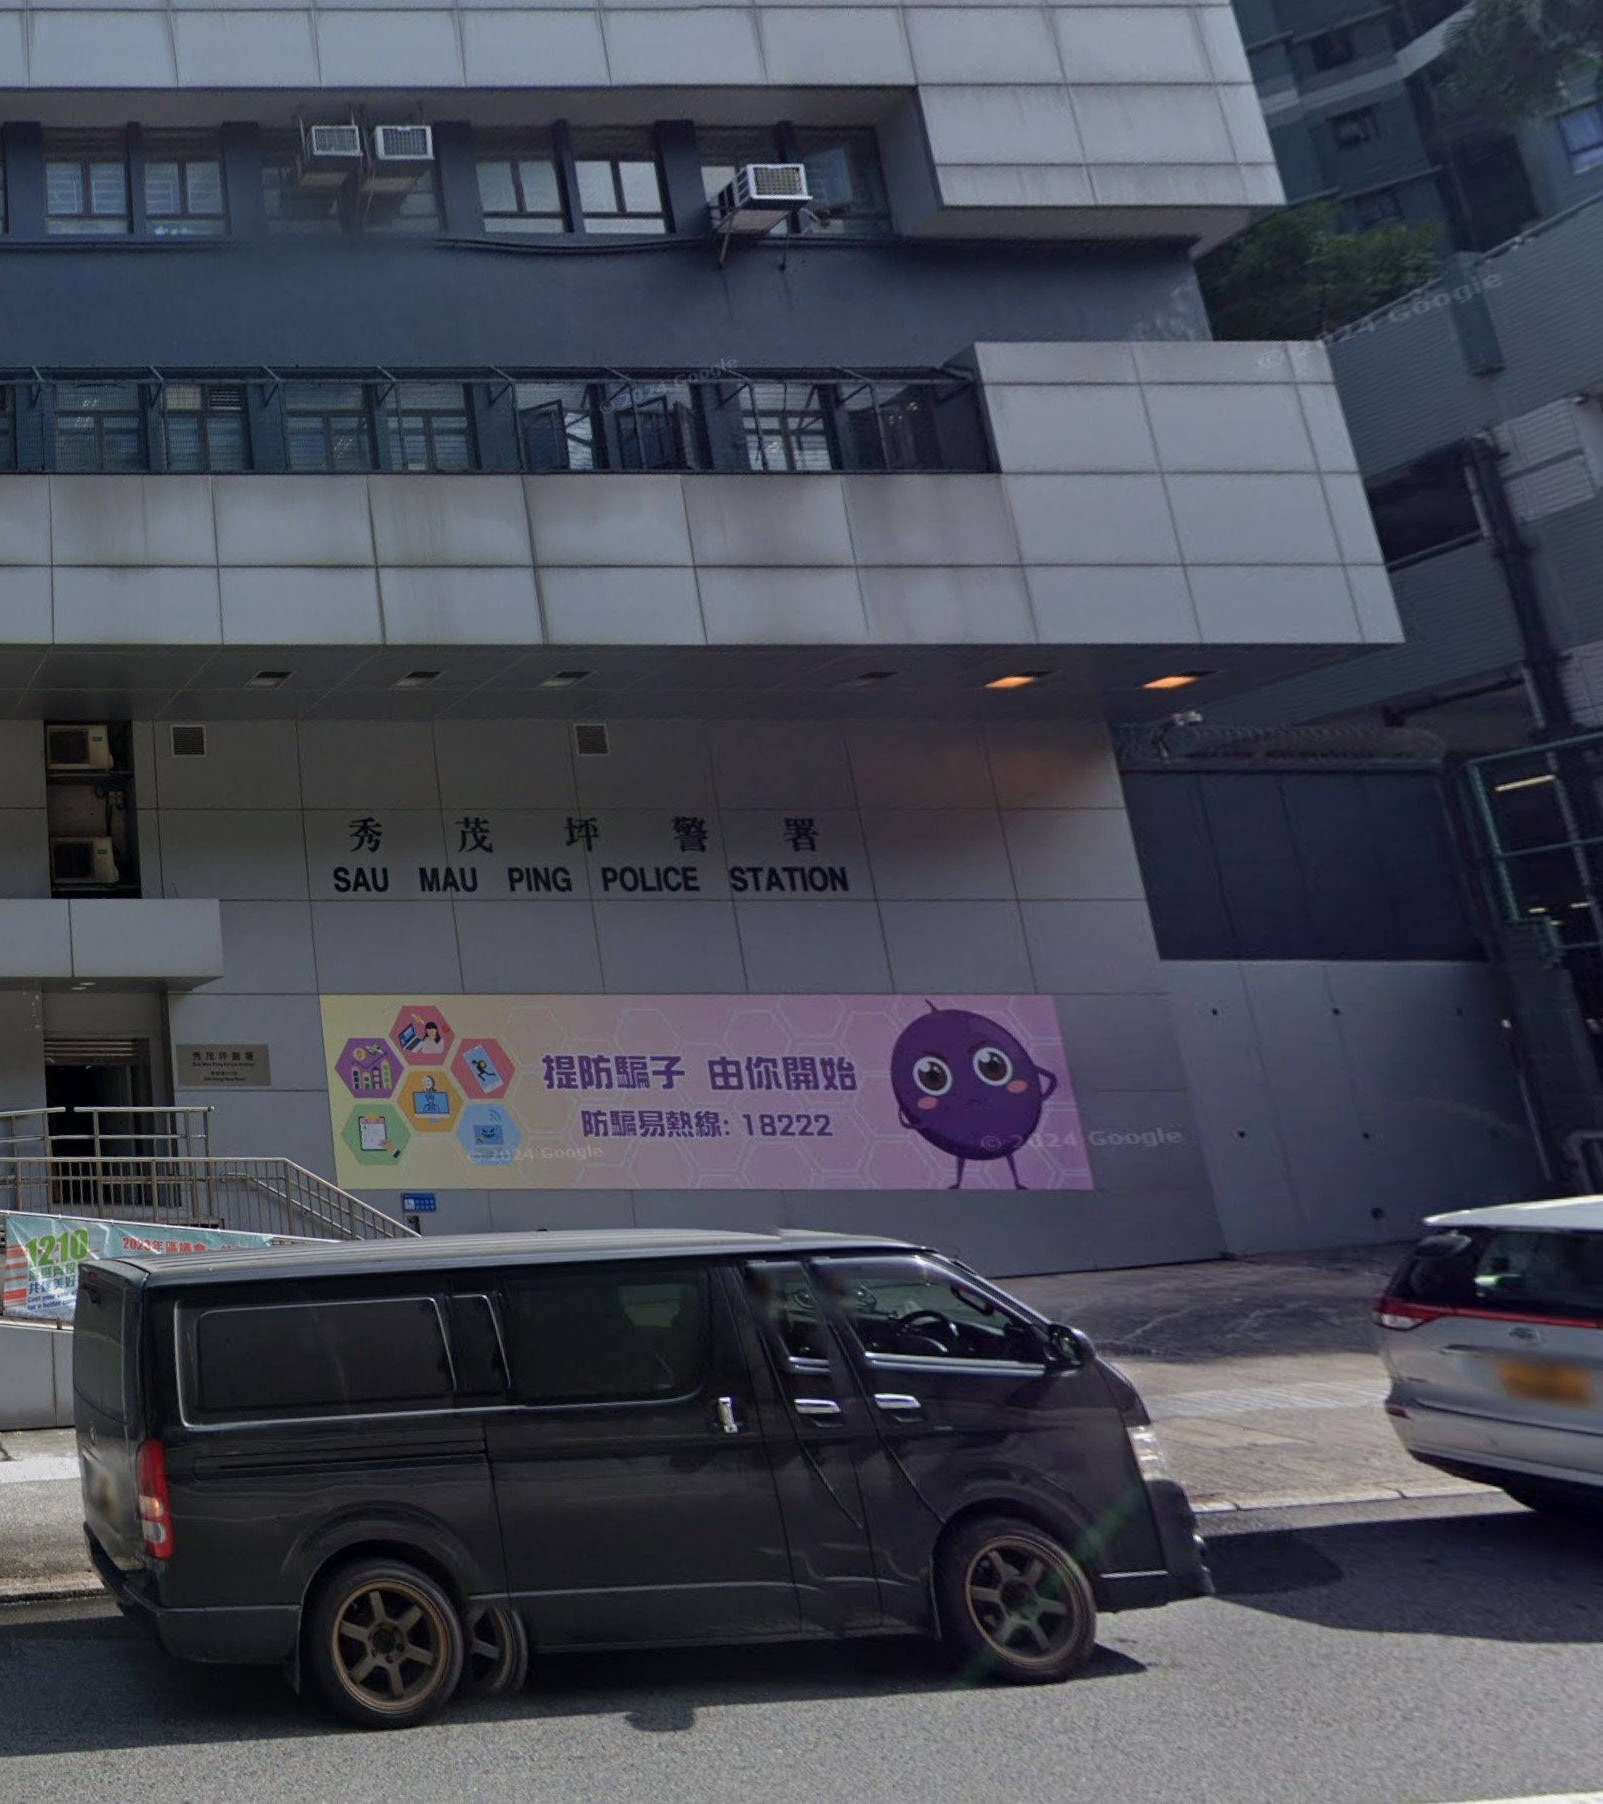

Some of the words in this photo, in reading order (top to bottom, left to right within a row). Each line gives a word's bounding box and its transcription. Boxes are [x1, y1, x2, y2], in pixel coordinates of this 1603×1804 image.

[349, 815, 818, 854] 秀茂坪警署
[332, 866, 390, 893] SAU
[418, 866, 478, 893] MAU
[508, 866, 572, 893] PING
[601, 866, 701, 893] POLICE
[729, 866, 850, 893] STATION
[542, 1054, 686, 1092] 提防騙子
[707, 1054, 858, 1092] 由你開始
[580, 1110, 730, 1139] 防騙易熱線:
[741, 1111, 834, 1138] 18222
[25, 1228, 89, 1267] 1210
